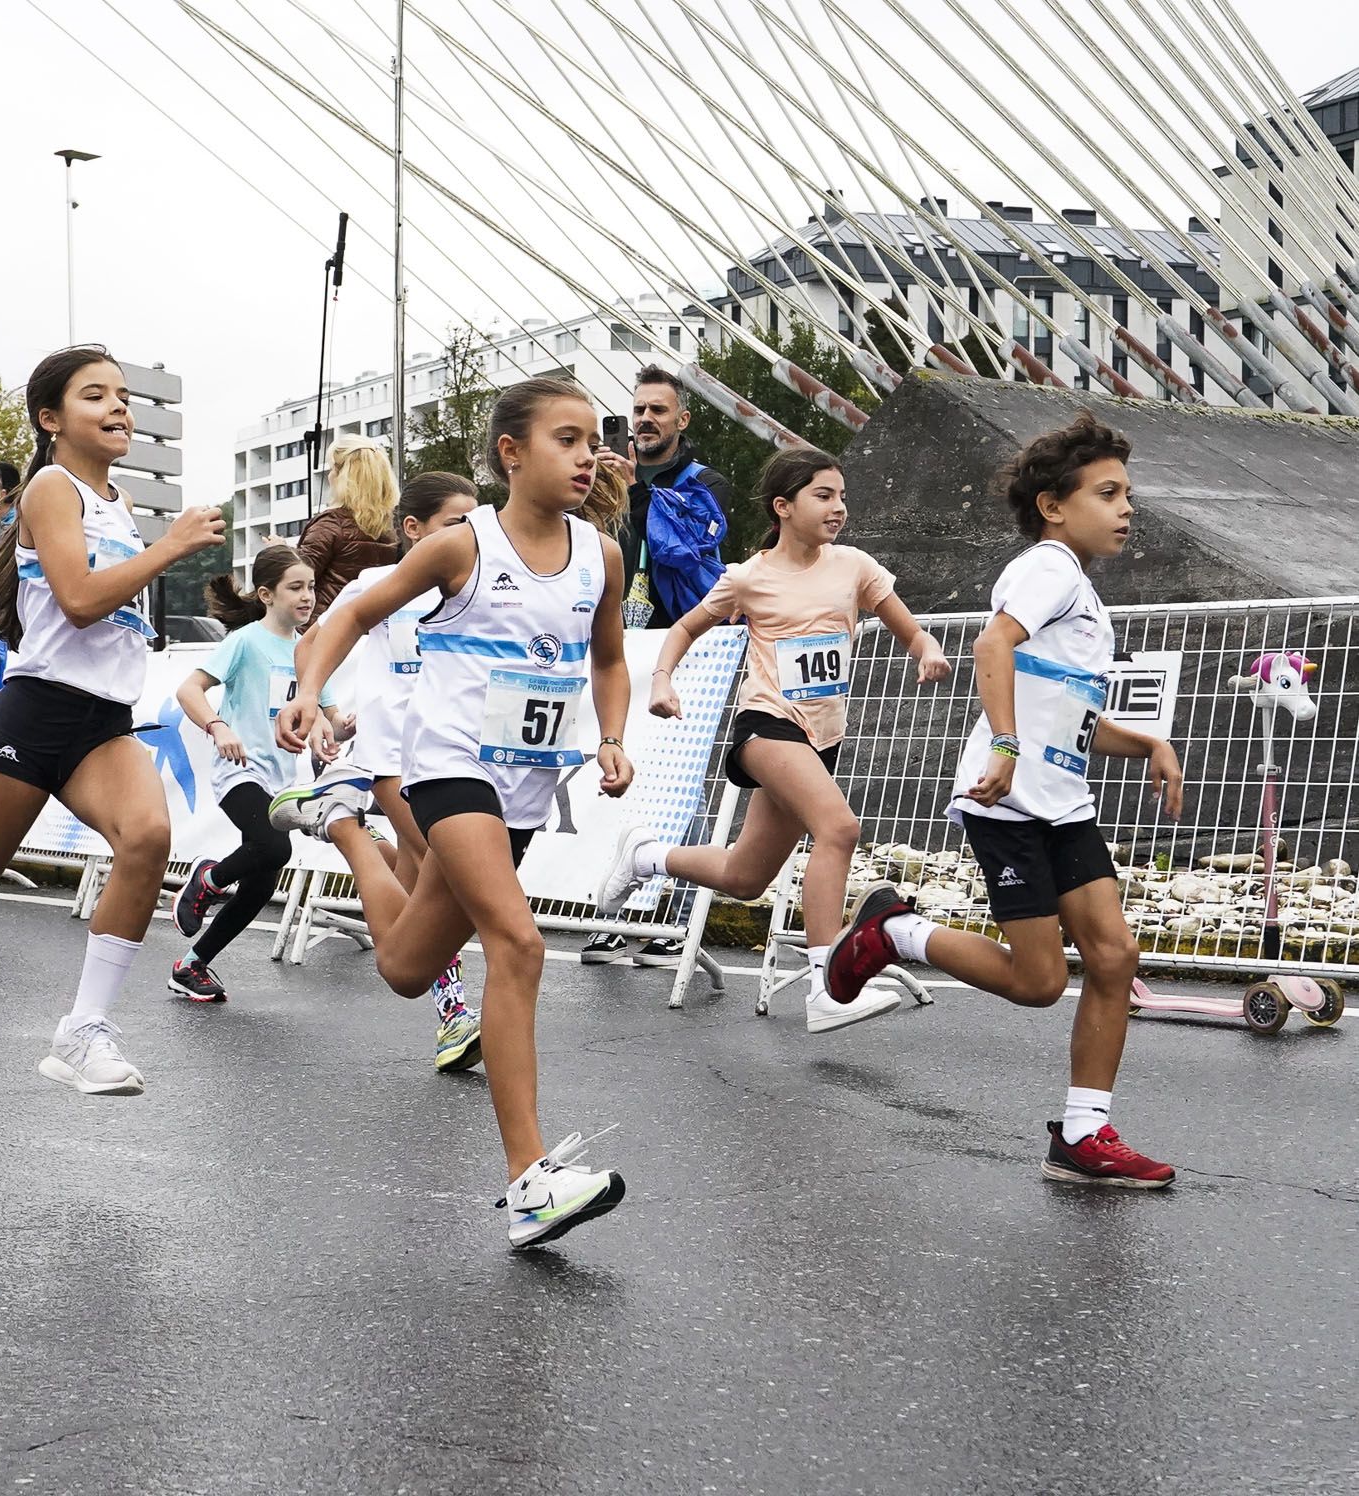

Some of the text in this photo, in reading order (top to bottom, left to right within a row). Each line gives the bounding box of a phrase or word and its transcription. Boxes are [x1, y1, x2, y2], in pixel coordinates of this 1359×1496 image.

[795, 650, 841, 684] 149
[522, 699, 566, 746] 57
[1075, 708, 1100, 754] 5
